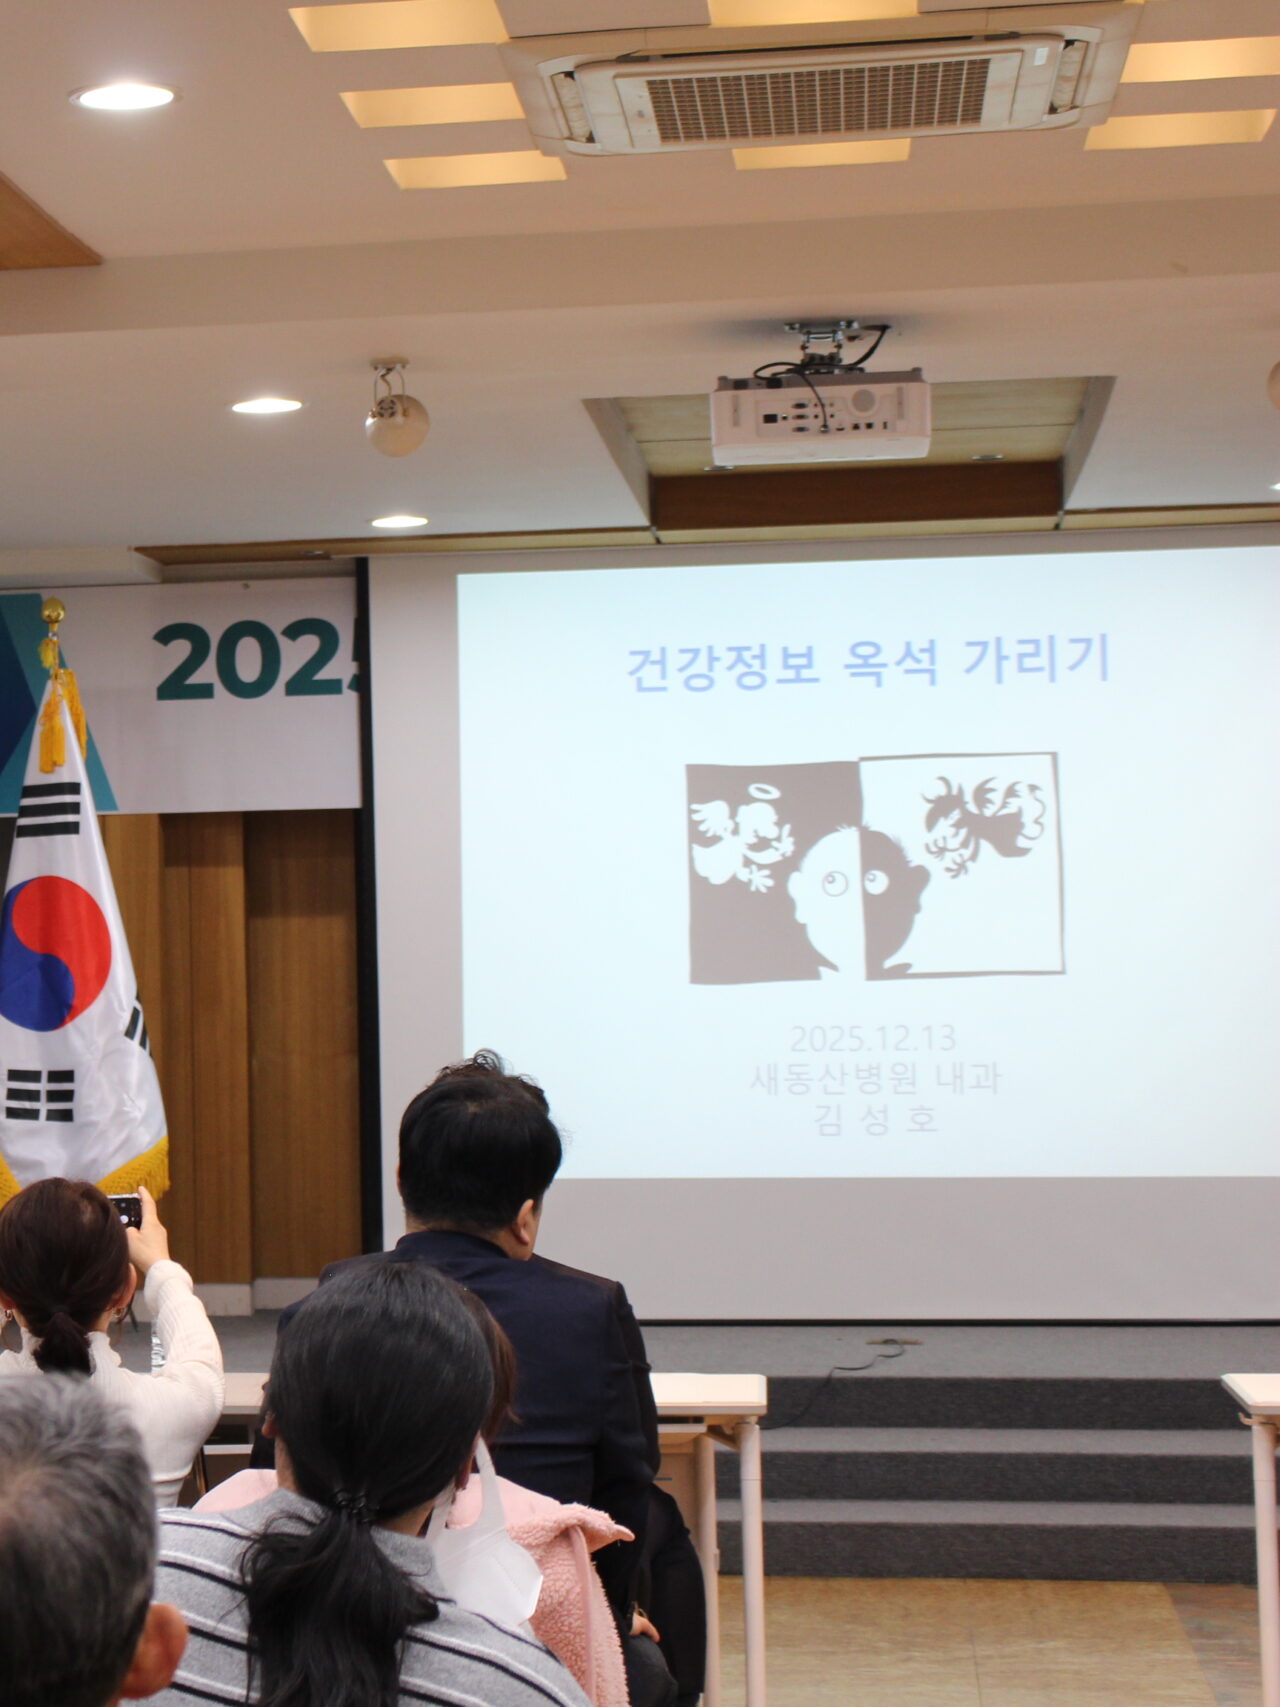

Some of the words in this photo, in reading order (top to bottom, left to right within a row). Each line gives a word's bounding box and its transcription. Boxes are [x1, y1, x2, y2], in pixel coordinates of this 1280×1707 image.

[153, 617, 359, 701] 202
[627, 643, 821, 693] 건강정보
[843, 638, 938, 688] 옥석
[963, 632, 1109, 685] 가리기
[790, 1023, 957, 1052] 2025.12.13
[749, 1061, 918, 1097] 새동산병원
[934, 1061, 1003, 1096] 내과
